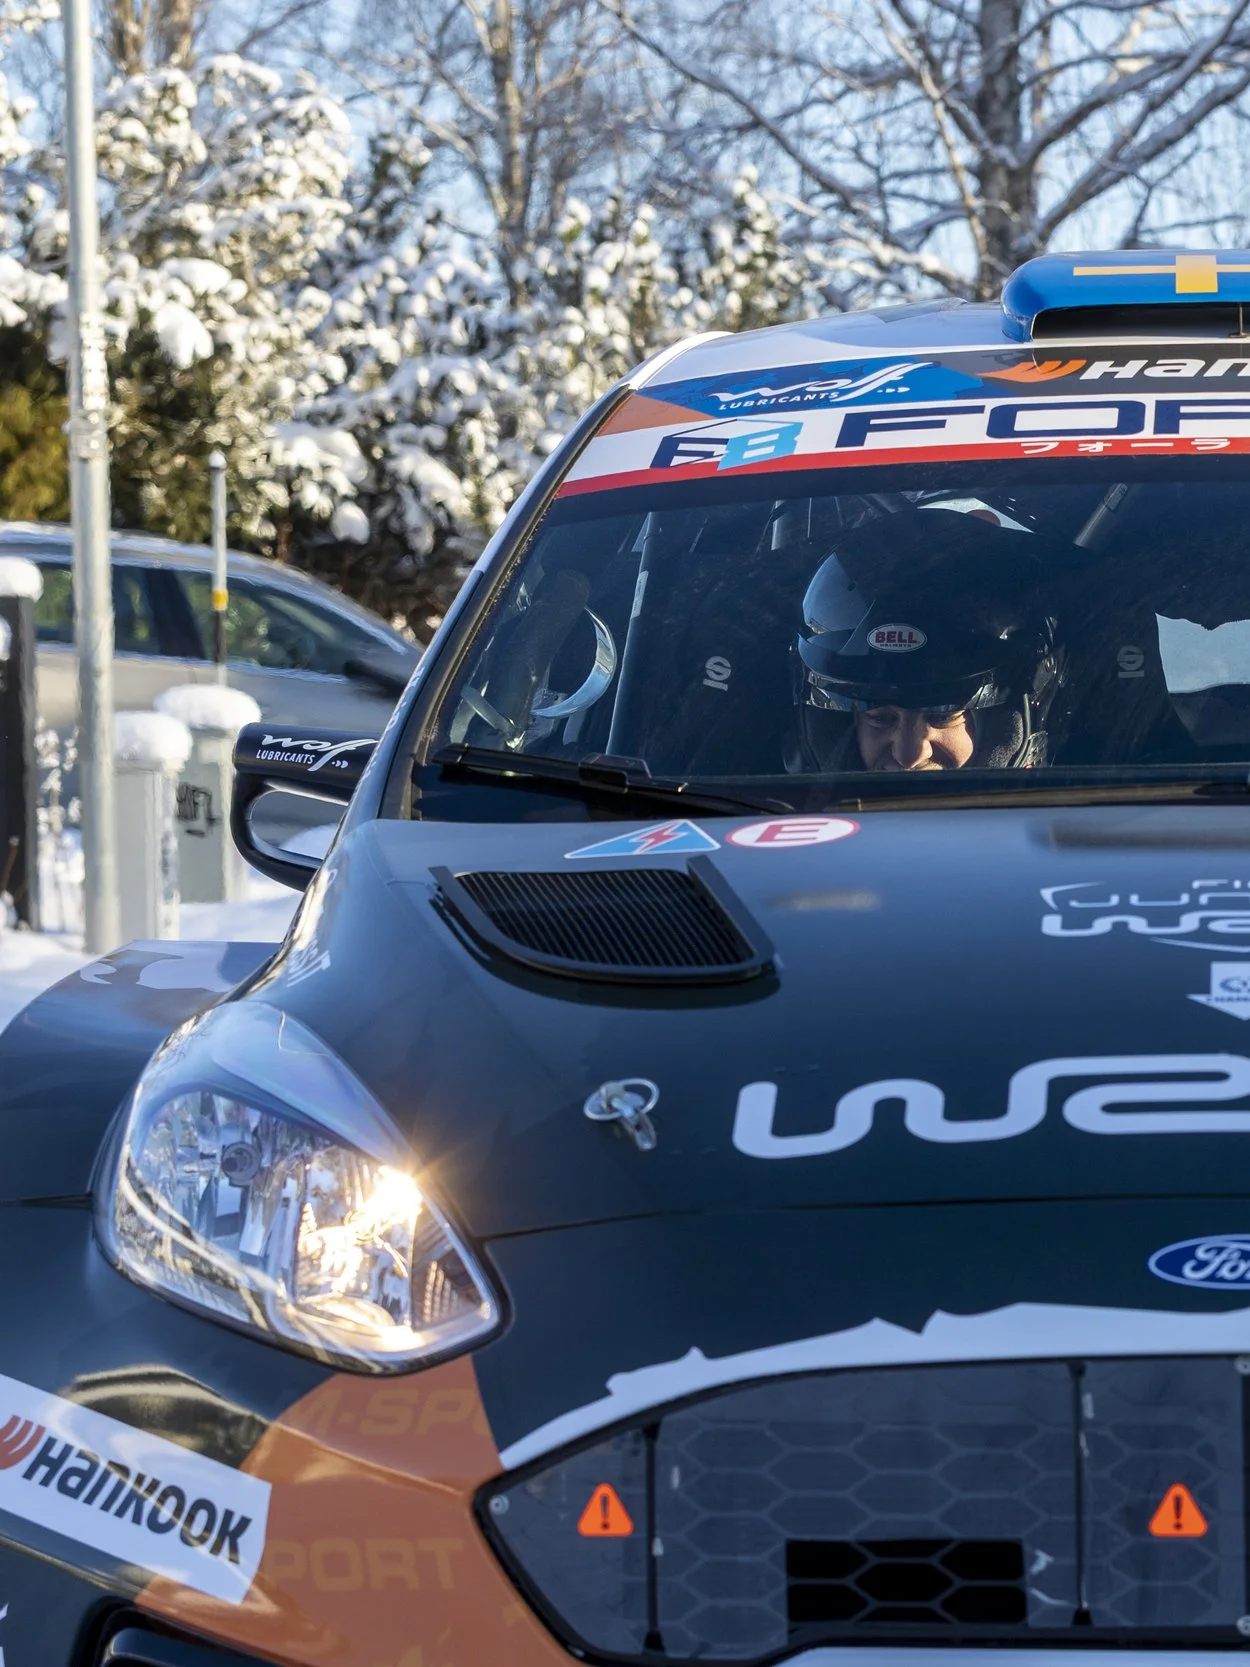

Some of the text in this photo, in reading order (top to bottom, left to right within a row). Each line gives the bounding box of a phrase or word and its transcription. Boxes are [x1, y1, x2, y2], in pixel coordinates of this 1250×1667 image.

[718, 391, 840, 411] LUBRICANTS
[875, 630, 917, 644] BELL
[255, 749, 316, 765] LUBRICANTS
[754, 821, 829, 844] E
